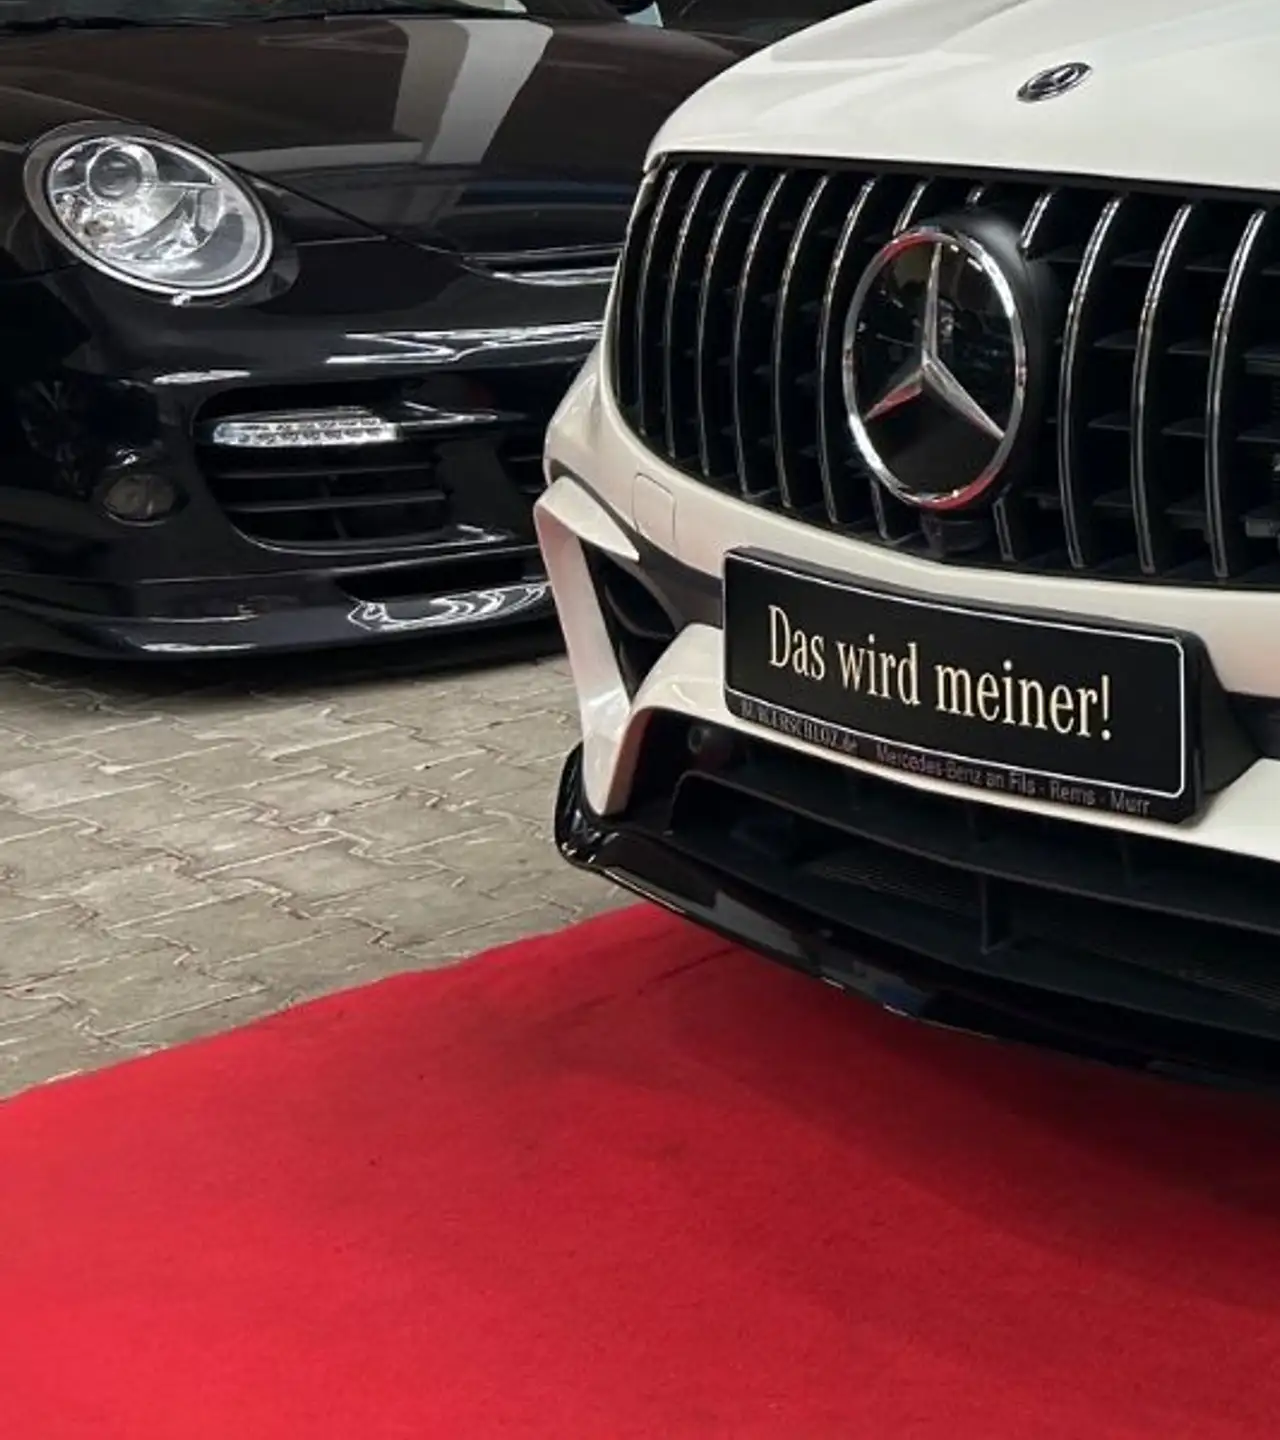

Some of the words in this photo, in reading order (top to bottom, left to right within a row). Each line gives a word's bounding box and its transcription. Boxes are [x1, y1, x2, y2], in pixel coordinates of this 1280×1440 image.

[768, 604, 826, 681] Das
[835, 633, 921, 706] wird
[934, 659, 1113, 741] meiner!
